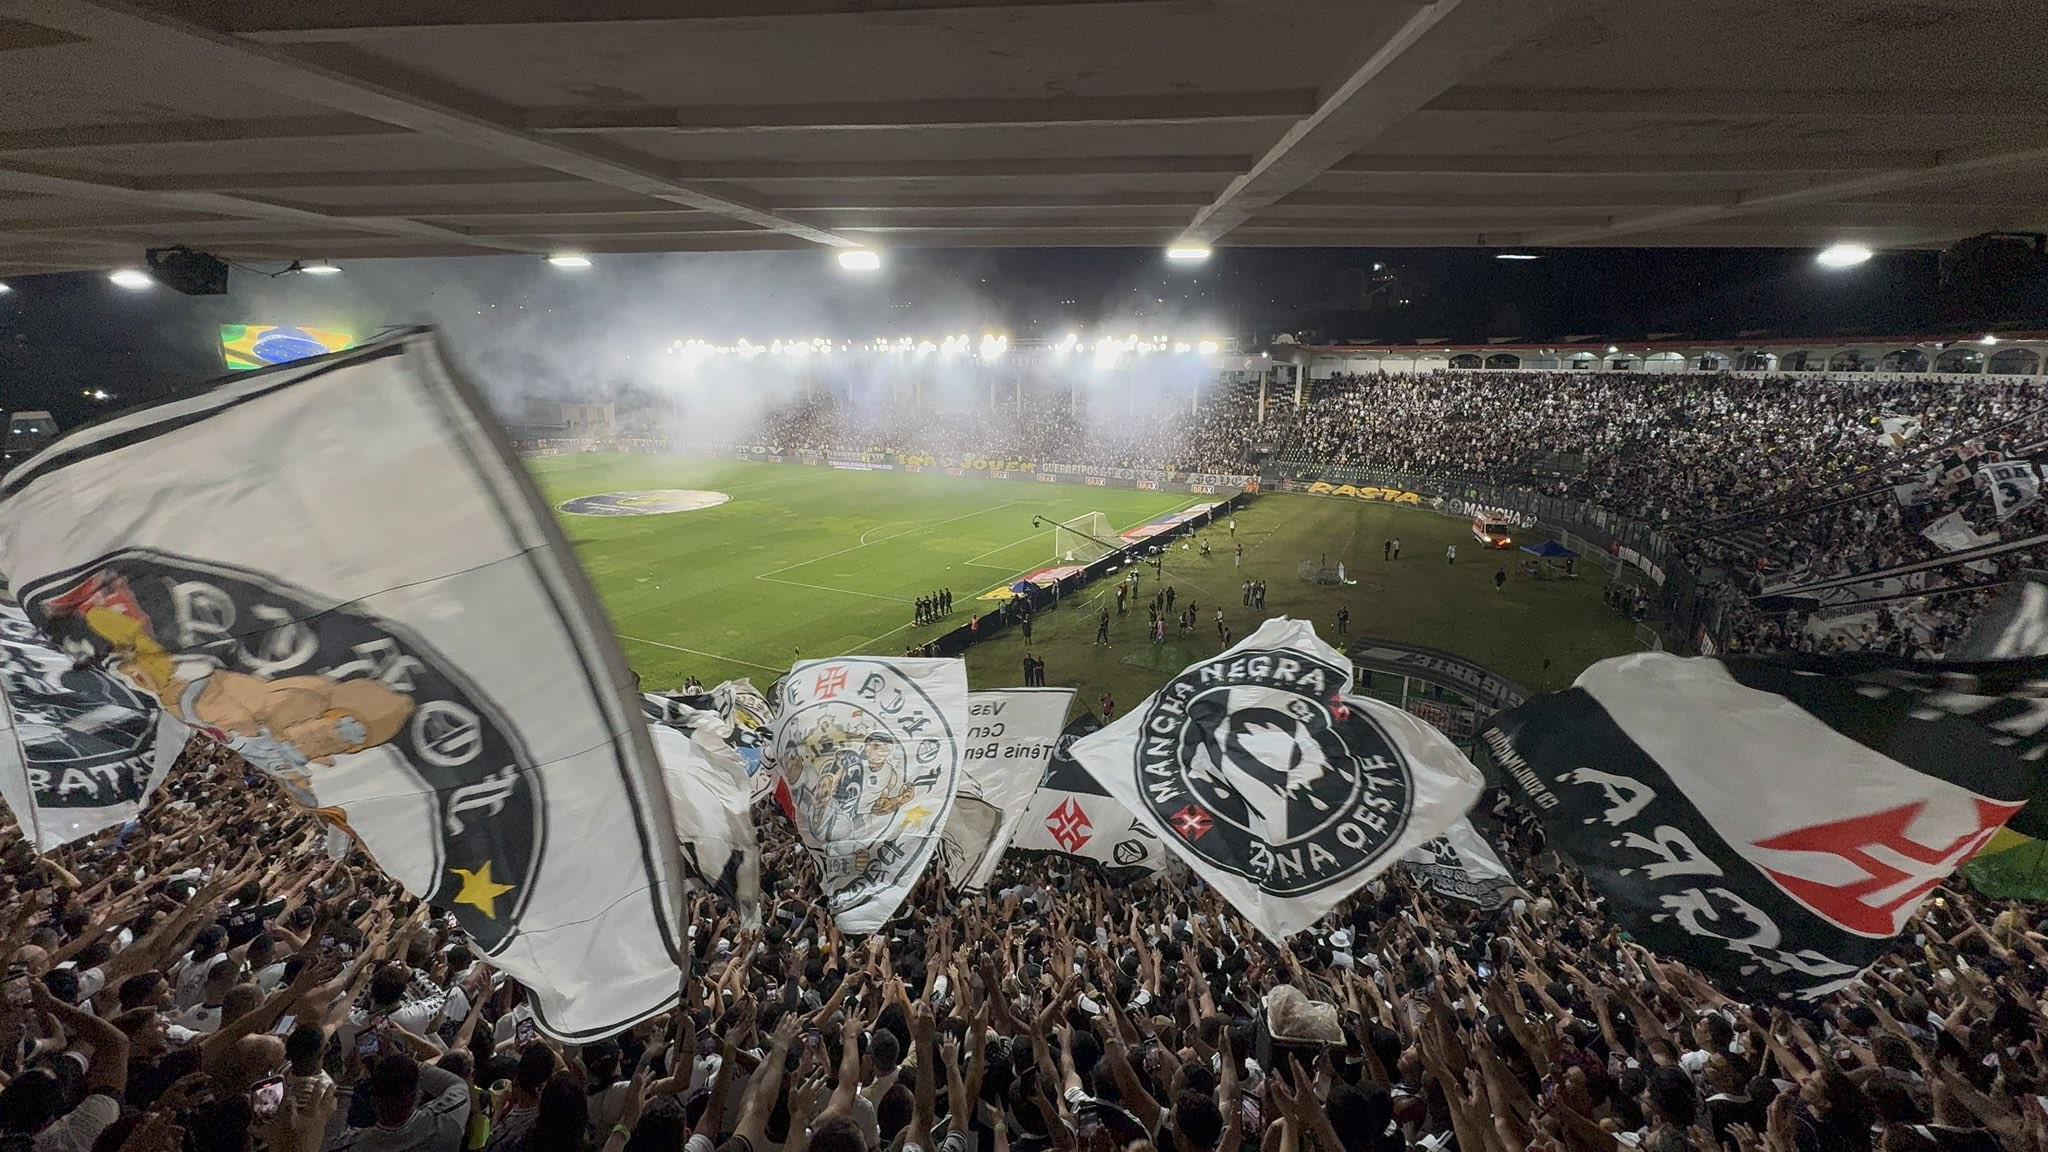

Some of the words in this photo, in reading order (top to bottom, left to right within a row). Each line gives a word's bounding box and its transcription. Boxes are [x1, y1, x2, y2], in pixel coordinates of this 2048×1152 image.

[1087, 478, 1104, 486] BRAX
[1193, 486, 1213, 494] BRAX
[1308, 481, 1421, 505] RASTA
[1141, 682, 1194, 803] MANCHA
[1200, 655, 1326, 697] NEGRA
[1337, 754, 1396, 851] OESTE
